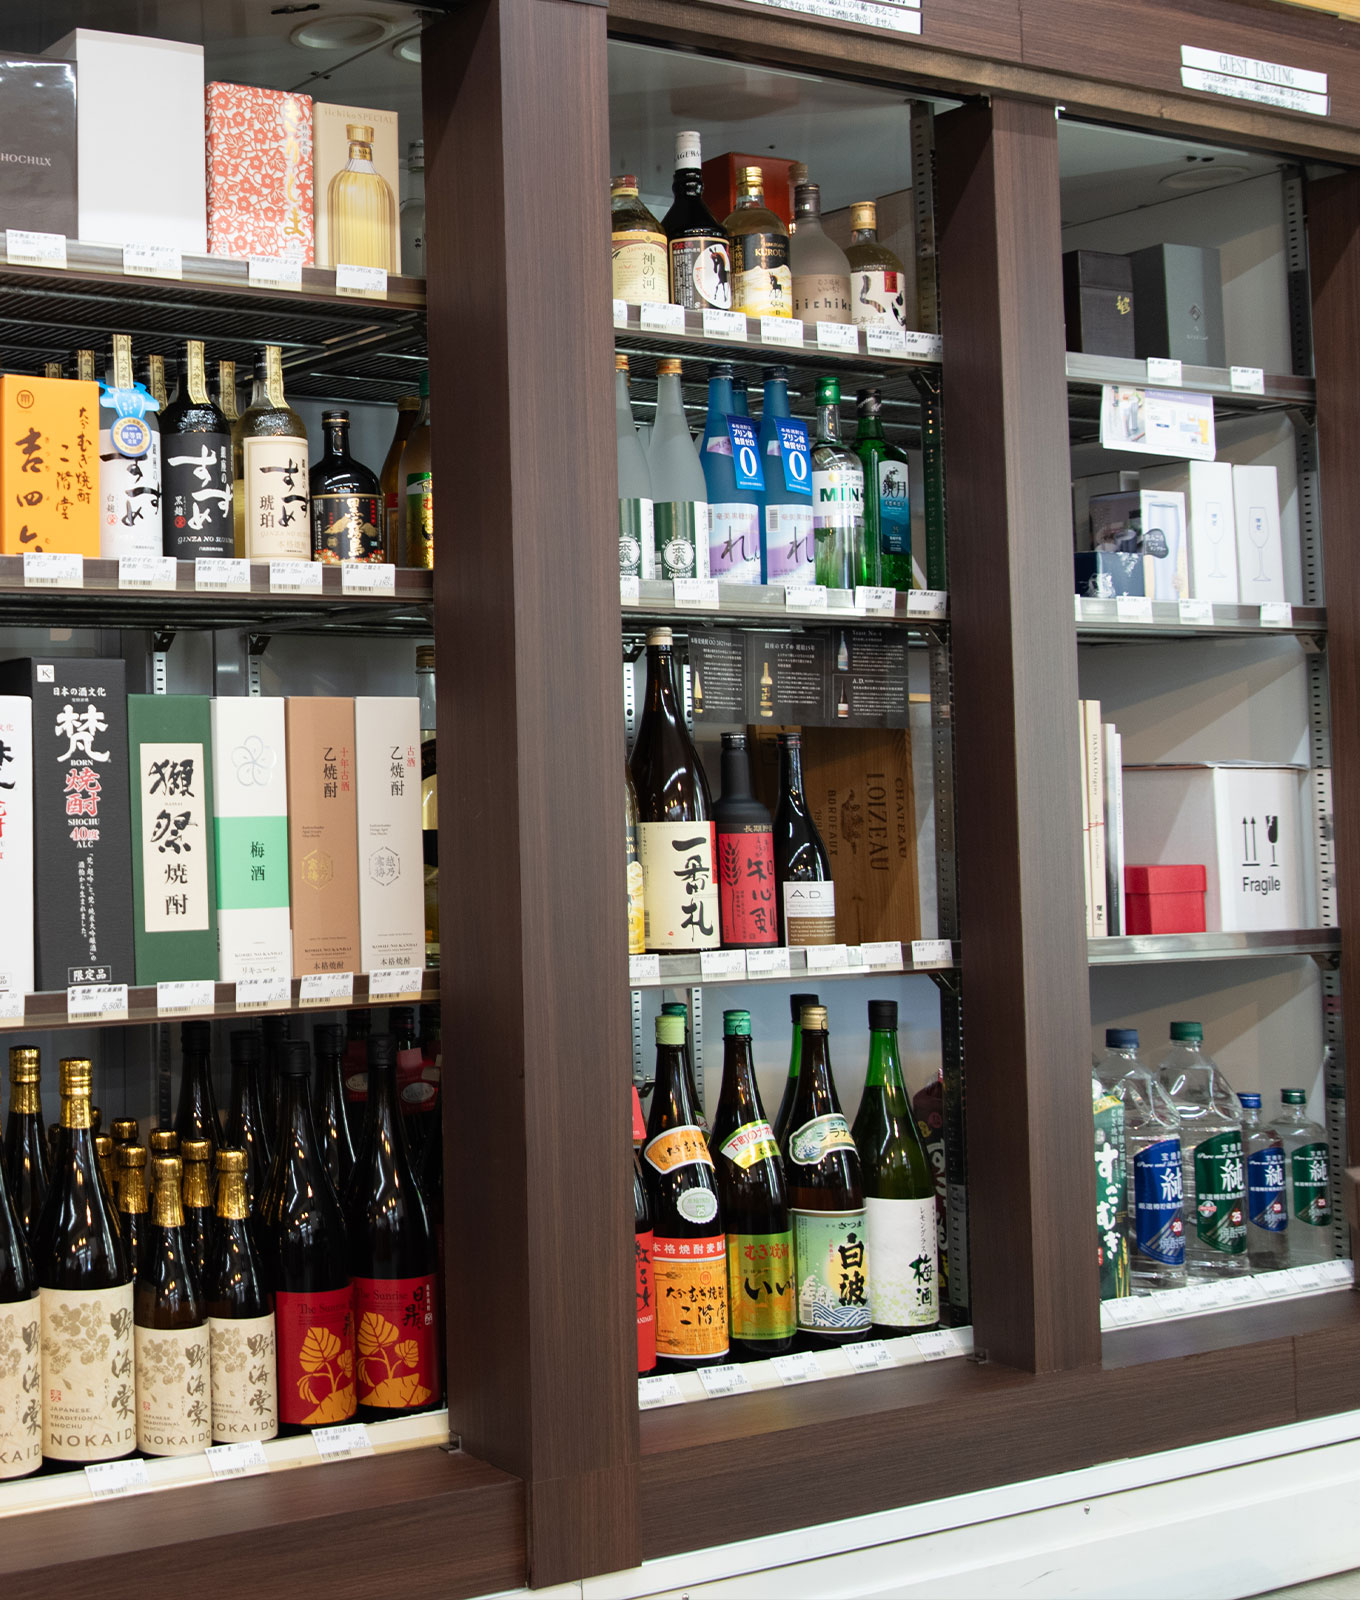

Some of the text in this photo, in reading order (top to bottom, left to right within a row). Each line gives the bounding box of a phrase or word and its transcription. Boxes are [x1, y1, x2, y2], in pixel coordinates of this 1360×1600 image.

[1219, 55, 1295, 85] GUEST TASTING
[642, 252, 656, 291] 神の河
[732, 429, 754, 439] プリン体
[734, 437, 756, 447] 糖質ゼロ
[781, 433, 806, 444] プリン体
[783, 441, 807, 452] 糖質ゼロ
[739, 446, 758, 477] 0
[788, 450, 808, 481] 0
[55, 444, 75, 520] 二階堂
[168, 443, 235, 531] すずめ
[259, 458, 310, 528] すずめ
[259, 495, 275, 529] 琥珀
[53, 686, 107, 697] 日本の酒文化
[55, 704, 112, 763] 梵
[323, 747, 339, 799] 乙焼酎
[339, 747, 351, 793] 十年古酒
[390, 746, 405, 798] 乙焼酎
[406, 746, 416, 768] 古酒
[63, 767, 103, 817] 焼酎
[148, 758, 199, 855] 獺祭
[67, 818, 101, 826] SHOCHU
[827, 790, 838, 856] BORDEAUX
[895, 777, 907, 858] CHATEAU
[250, 841, 266, 882] 梅酒
[164, 863, 189, 916] 焼酎
[671, 836, 714, 943] 一番札
[790, 889, 822, 899] A.D.
[1242, 876, 1281, 895] Fragile
[72, 968, 108, 982] 限定品
[241, 966, 277, 974] リキュール
[313, 962, 345, 971] 本格焼酎
[379, 957, 411, 966] 本格焼酎
[1160, 1167, 1183, 1202] 純
[1219, 1158, 1245, 1192] 純
[1264, 1164, 1285, 1187] 純
[1309, 1160, 1329, 1182] 純
[1094, 1142, 1122, 1260] すごむぎ
[1231, 1211, 1242, 1223] 25
[838, 1220, 863, 1230] さつま
[919, 1206, 927, 1252] レモングラス
[1174, 1221, 1183, 1233] 20
[838, 1232, 868, 1307] 白波
[908, 1253, 937, 1308] 梅酒
[680, 1301, 727, 1327] 二階堂
[109, 1307, 135, 1422] 野海棠
[246, 1333, 272, 1416] 野海棠
[185, 1343, 209, 1428] 野海棠
